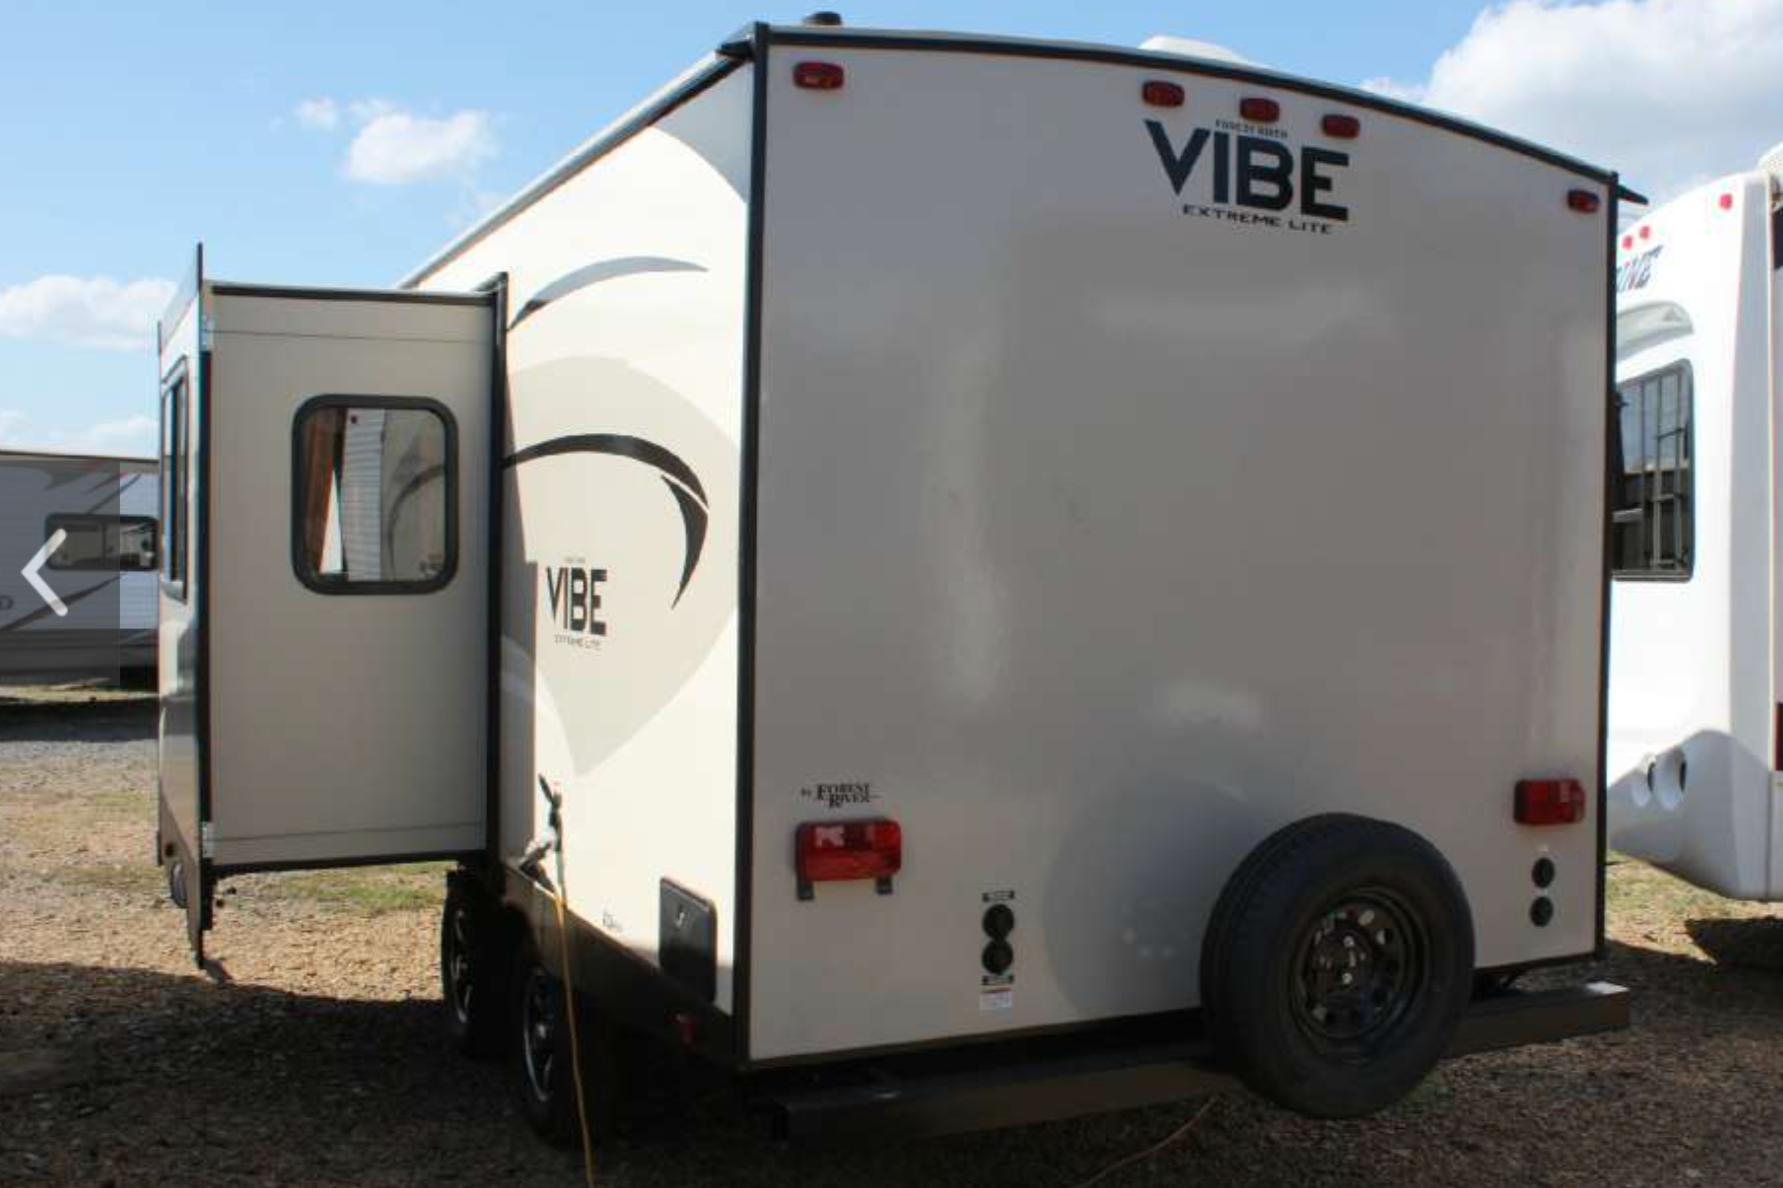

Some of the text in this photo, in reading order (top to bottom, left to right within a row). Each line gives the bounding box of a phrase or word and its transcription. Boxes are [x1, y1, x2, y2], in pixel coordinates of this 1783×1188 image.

[1144, 118, 1350, 222] VIBE
[1183, 204, 1332, 235] EXTREME LITE
[545, 566, 608, 637] VIBE
